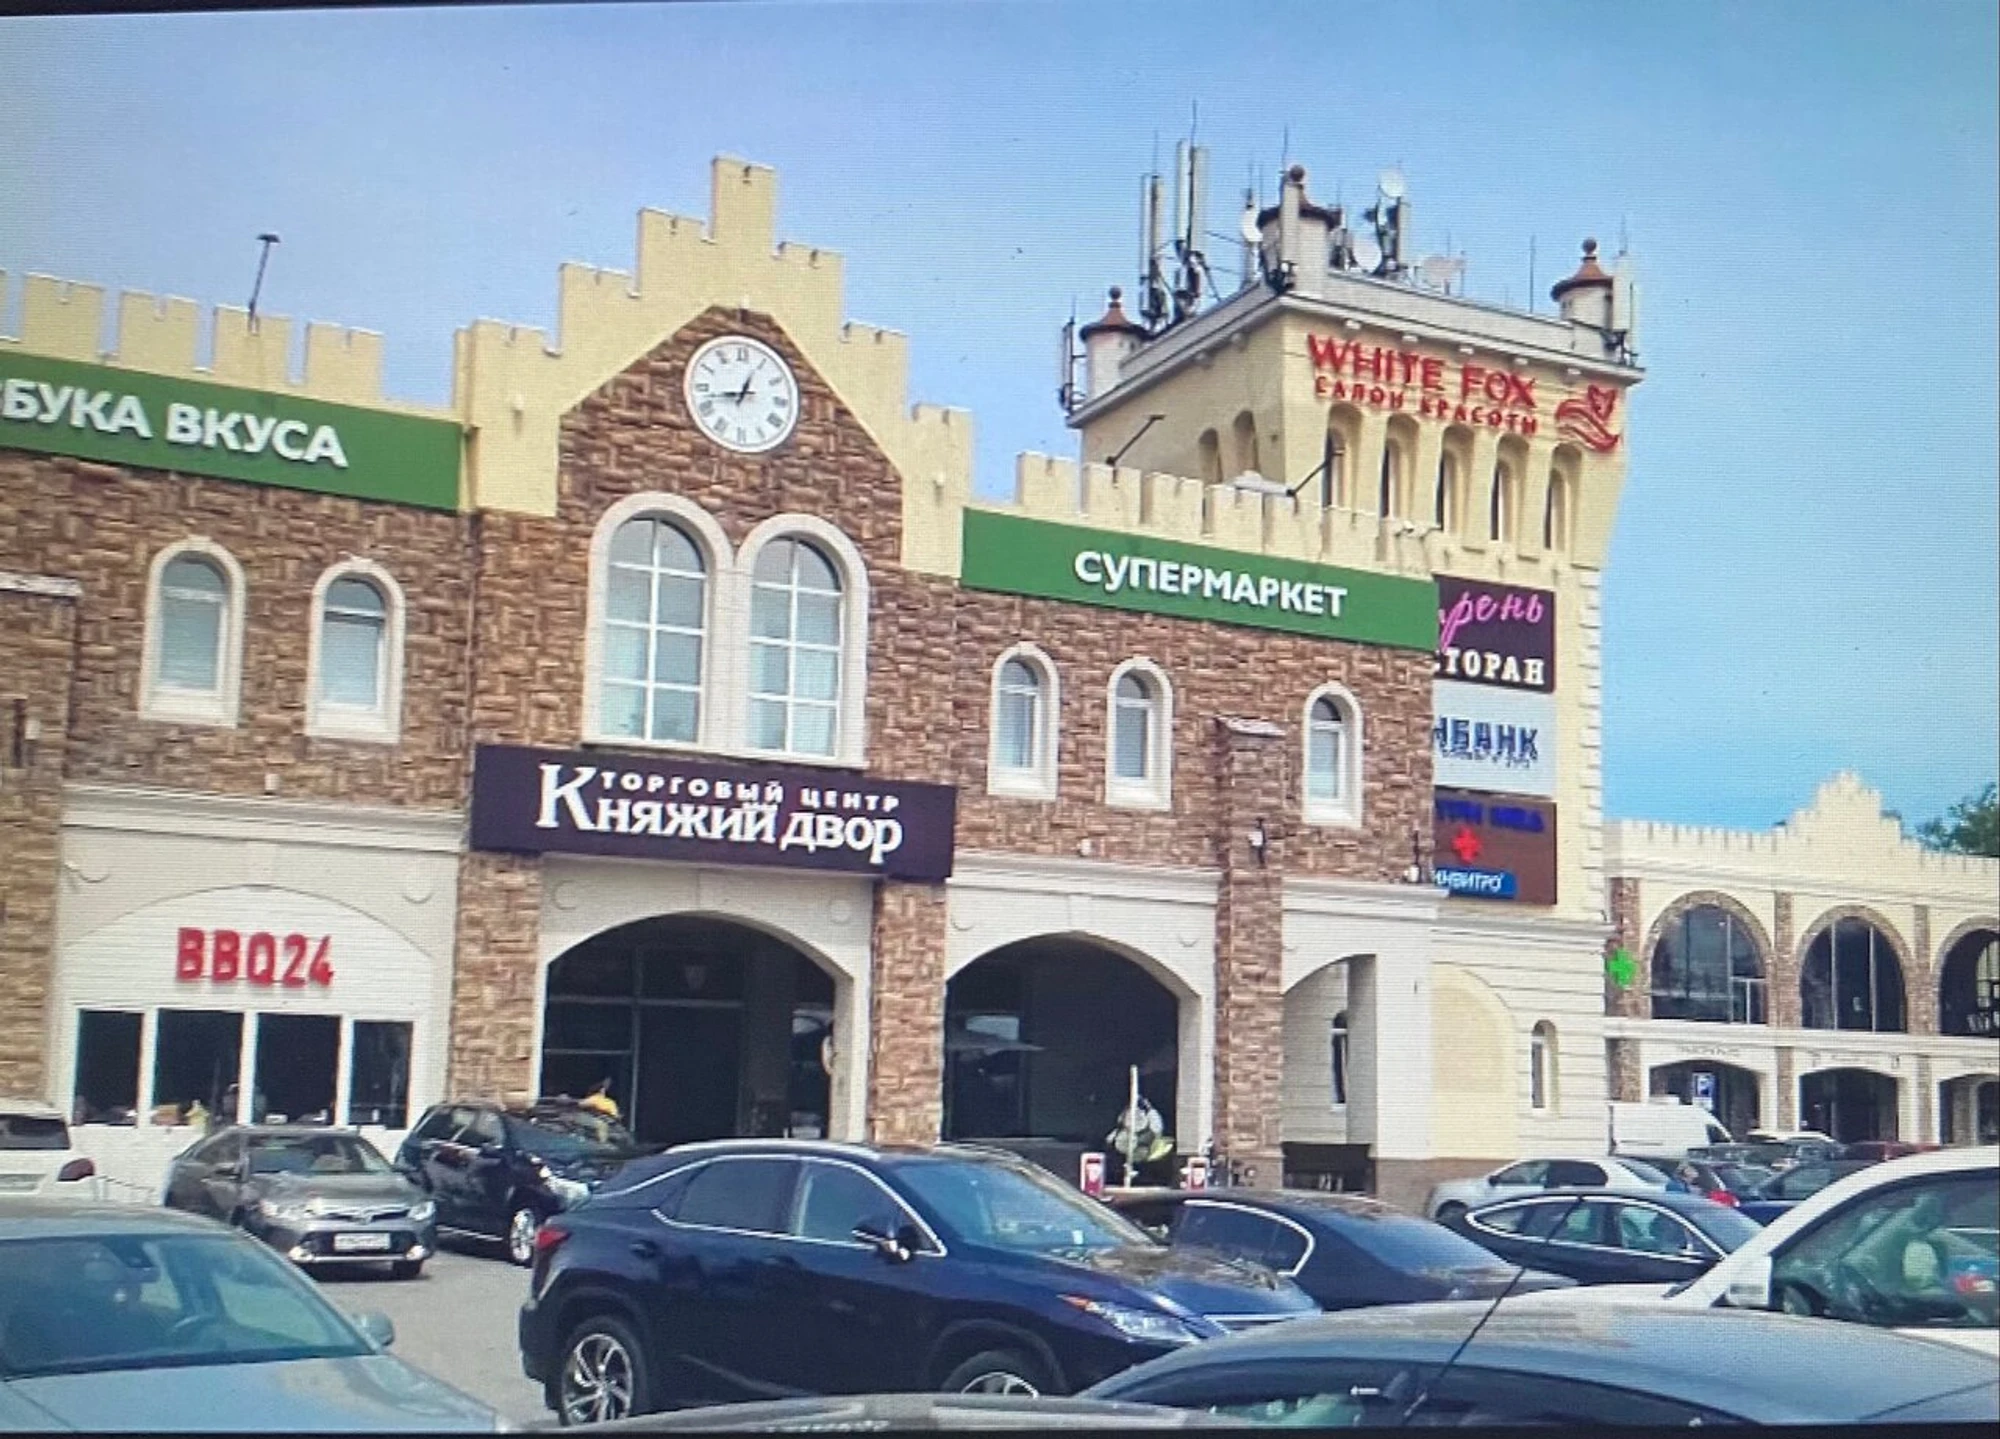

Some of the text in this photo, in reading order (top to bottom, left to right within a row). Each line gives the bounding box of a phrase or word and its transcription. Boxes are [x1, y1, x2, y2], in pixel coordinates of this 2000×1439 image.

[1308, 333, 1537, 409] WHITE FOX
[0, 377, 349, 469] БУКА ВКУСА
[1314, 376, 1538, 436] САЛОН КРАСОТЫ
[1074, 550, 1348, 618] СУПЕРМАРКЕТ
[1439, 591, 1544, 654] рень
[601, 771, 901, 813] ТОРГОВЫЙ ЦЕНТР
[176, 926, 335, 989] BBQ24
